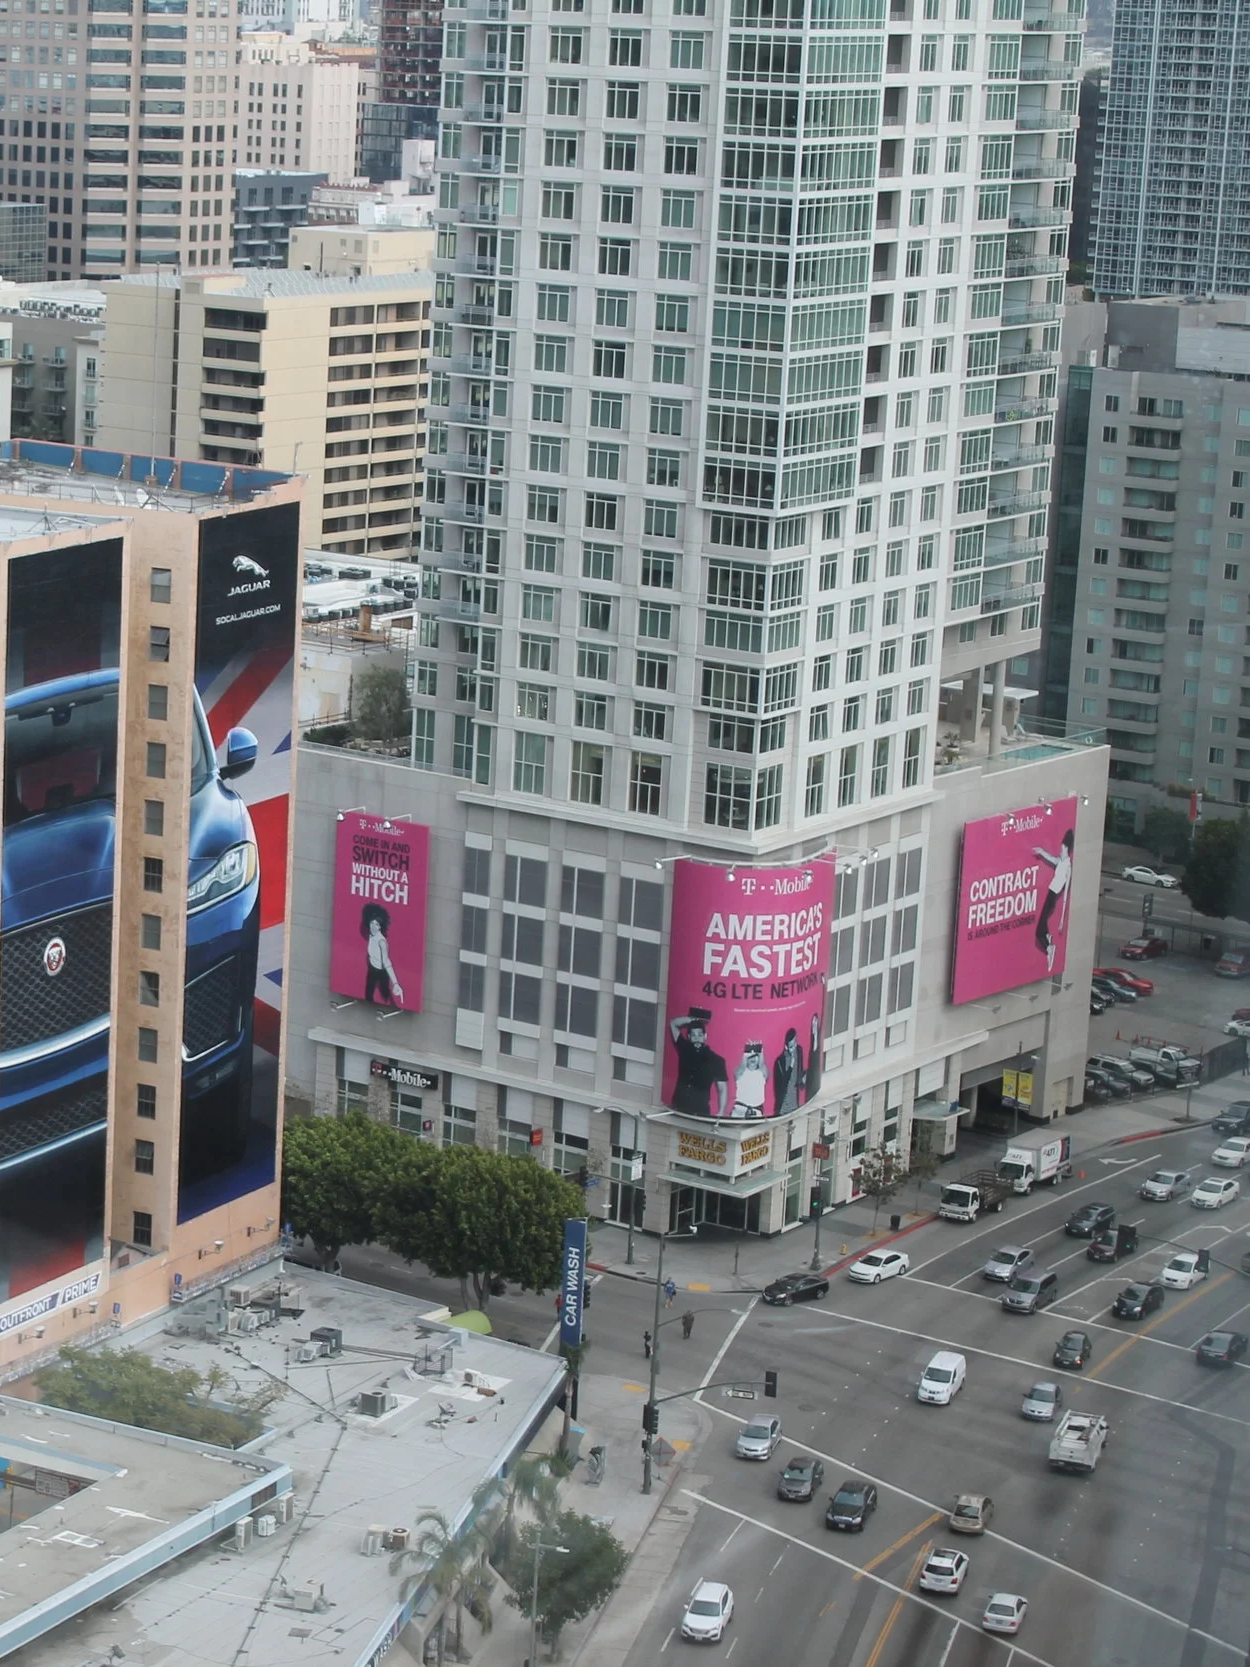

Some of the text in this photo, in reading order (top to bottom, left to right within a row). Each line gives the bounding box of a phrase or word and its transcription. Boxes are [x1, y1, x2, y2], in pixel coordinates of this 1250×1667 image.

[228, 580, 271, 597] JAGUAR
[215, 604, 281, 626] SOCALJAGUAR.COM
[352, 834, 410, 854] COME IN AND
[352, 845, 410, 871] SWITCH
[352, 861, 409, 884] WITHOUT A
[970, 865, 1039, 902] CONTRACT
[351, 874, 409, 905] HITCH
[968, 889, 1038, 929] FREEDOM
[706, 902, 823, 941] AMERICA'S
[974, 924, 998, 939] AROUND
[999, 921, 1011, 932] THE
[703, 932, 822, 979] FASTEST
[702, 973, 818, 1000] 4G LTE NETWORK
[678, 1131, 727, 1153] WELLS
[740, 1131, 770, 1152] WELLS
[678, 1144, 727, 1166] FARGO
[740, 1145, 769, 1166] FARGO
[565, 1246, 581, 1327] CAR WASH
[0, 1275, 98, 1331] OUTFRONT PRIME
